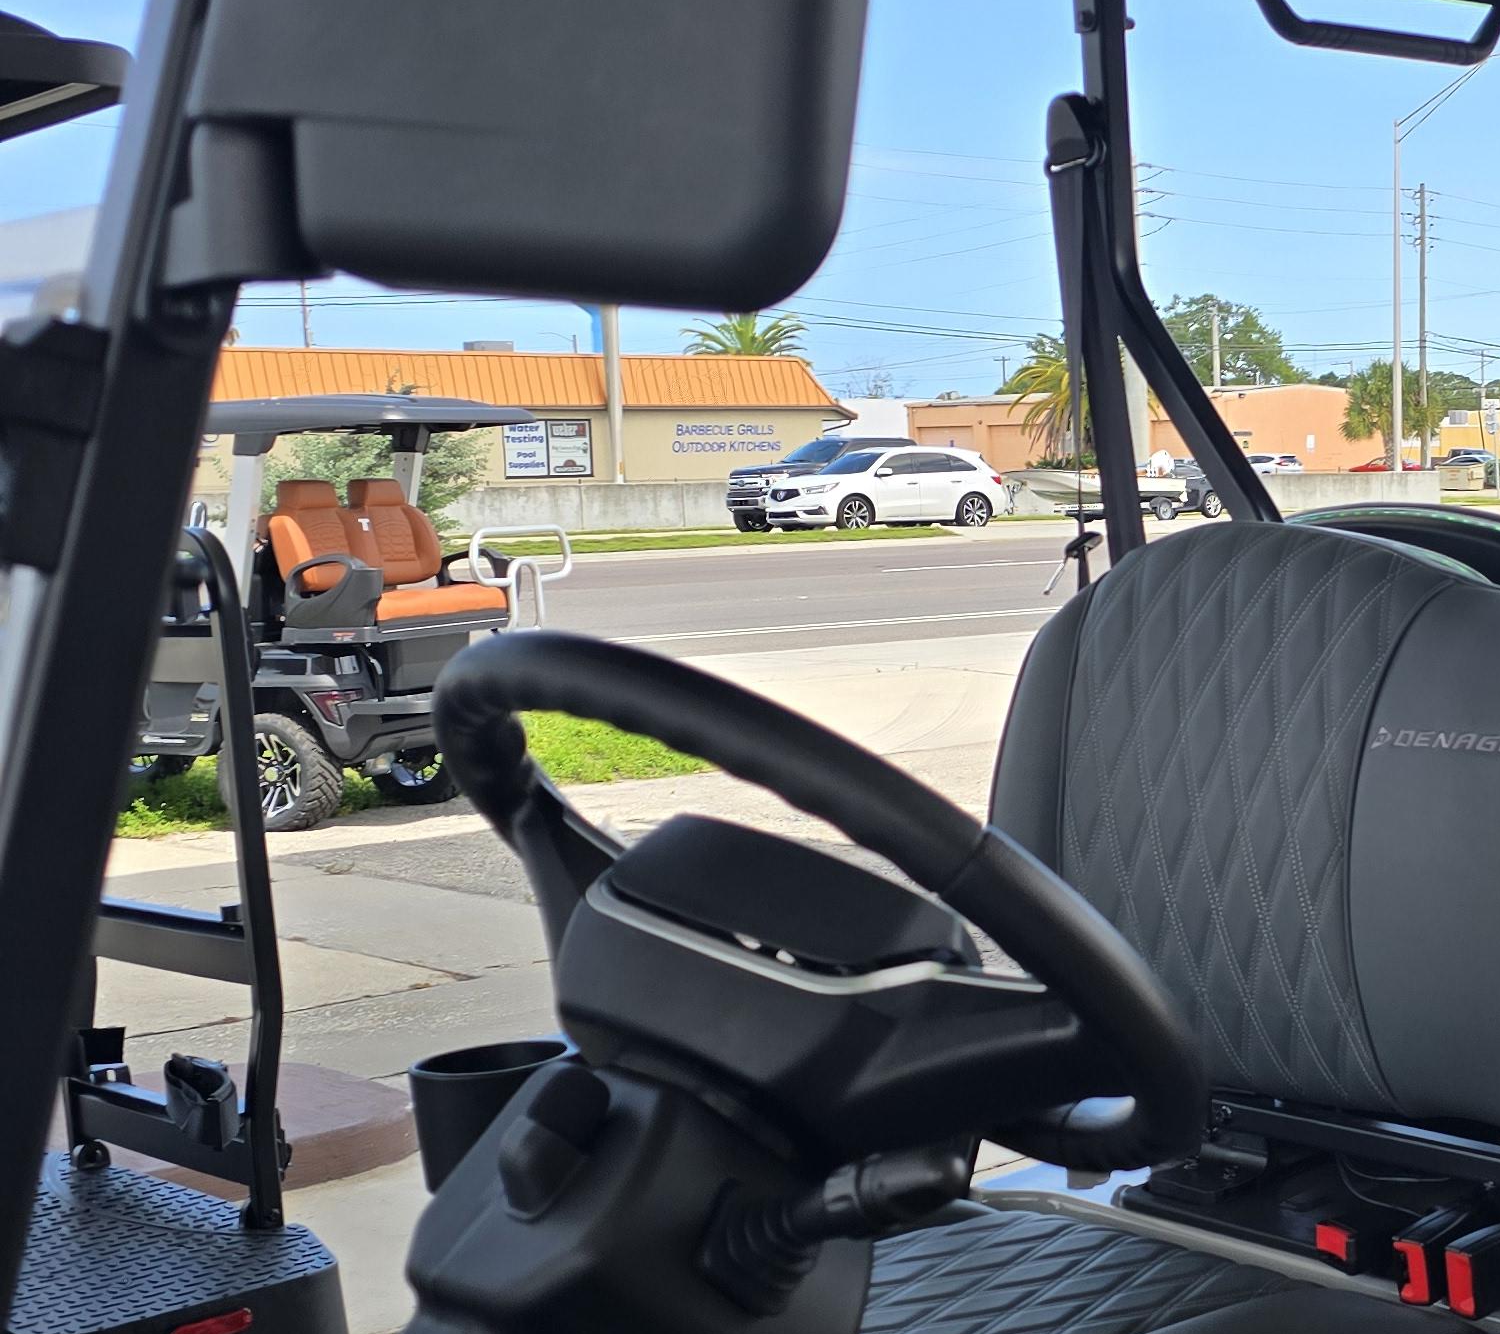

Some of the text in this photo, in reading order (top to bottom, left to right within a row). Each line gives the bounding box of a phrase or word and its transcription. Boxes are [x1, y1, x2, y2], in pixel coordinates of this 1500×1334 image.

[508, 423, 540, 433] Water
[675, 424, 775, 436] BARBECUE GRILLS
[504, 434, 545, 444] Testing
[672, 441, 781, 453] OUTDOOR KITCHENS
[516, 450, 537, 458] Pool
[508, 459, 546, 470] Supplies
